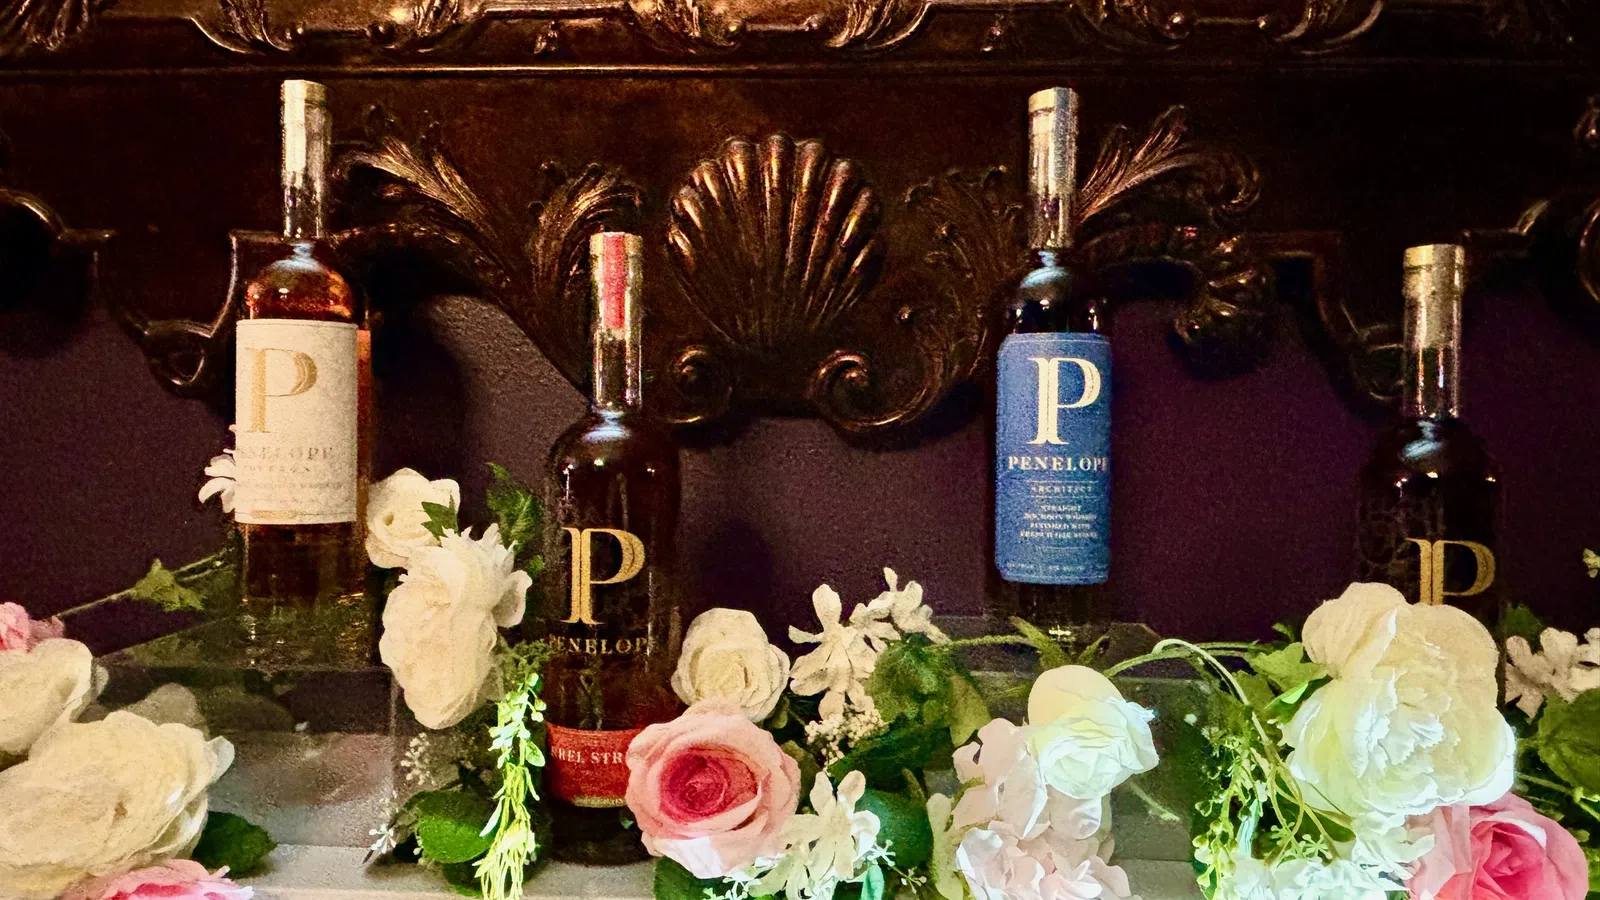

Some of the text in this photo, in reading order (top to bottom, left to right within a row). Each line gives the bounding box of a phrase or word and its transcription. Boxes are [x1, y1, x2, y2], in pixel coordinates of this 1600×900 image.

[244, 348, 318, 433] P
[1026, 357, 1101, 444] P
[560, 527, 645, 624] P
[1405, 538, 1496, 606] P
